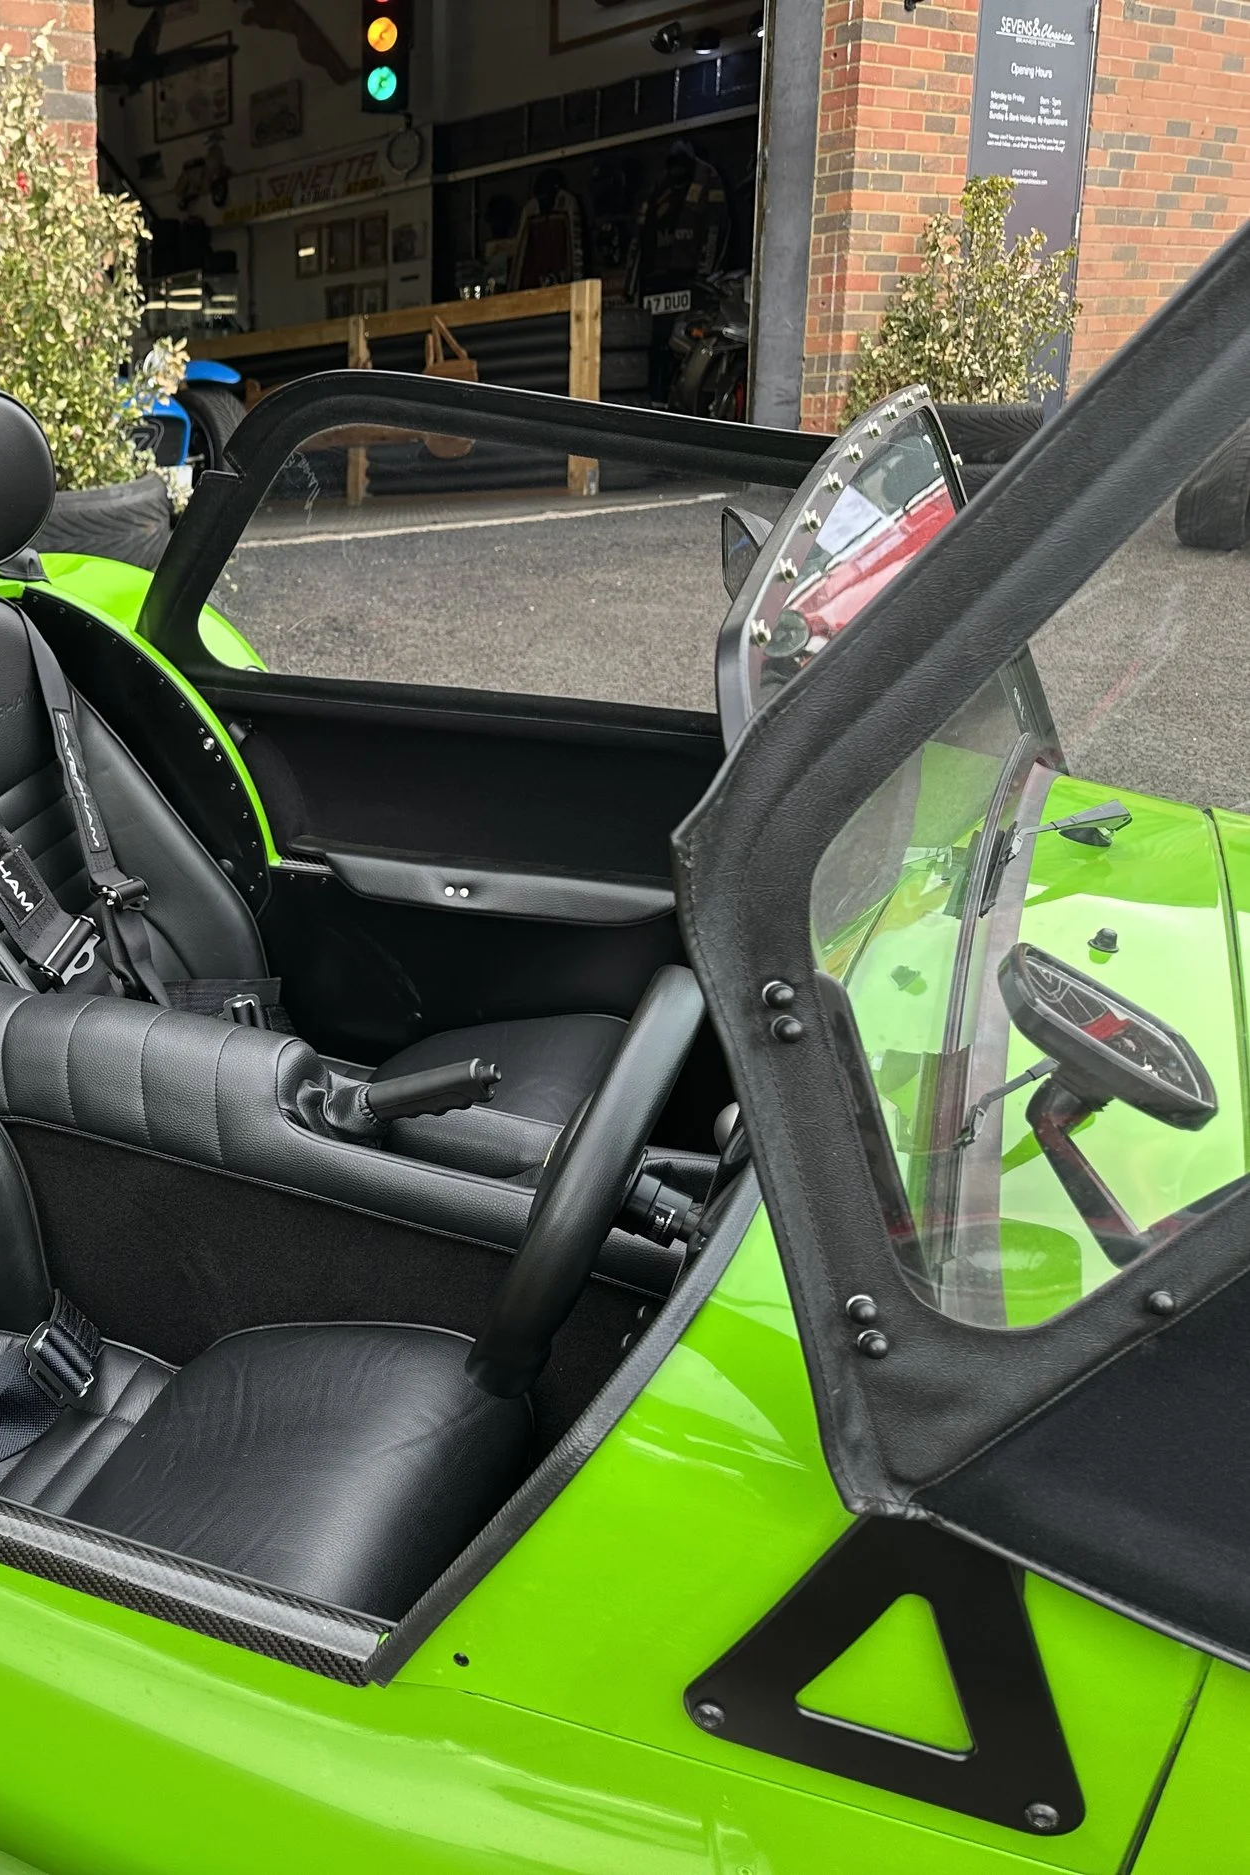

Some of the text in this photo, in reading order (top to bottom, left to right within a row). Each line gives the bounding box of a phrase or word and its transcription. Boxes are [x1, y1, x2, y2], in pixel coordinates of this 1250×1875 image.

[1011, 62, 1053, 79] Opening Hours
[267, 151, 379, 197] GINETTA
[664, 293, 689, 310] DUO
